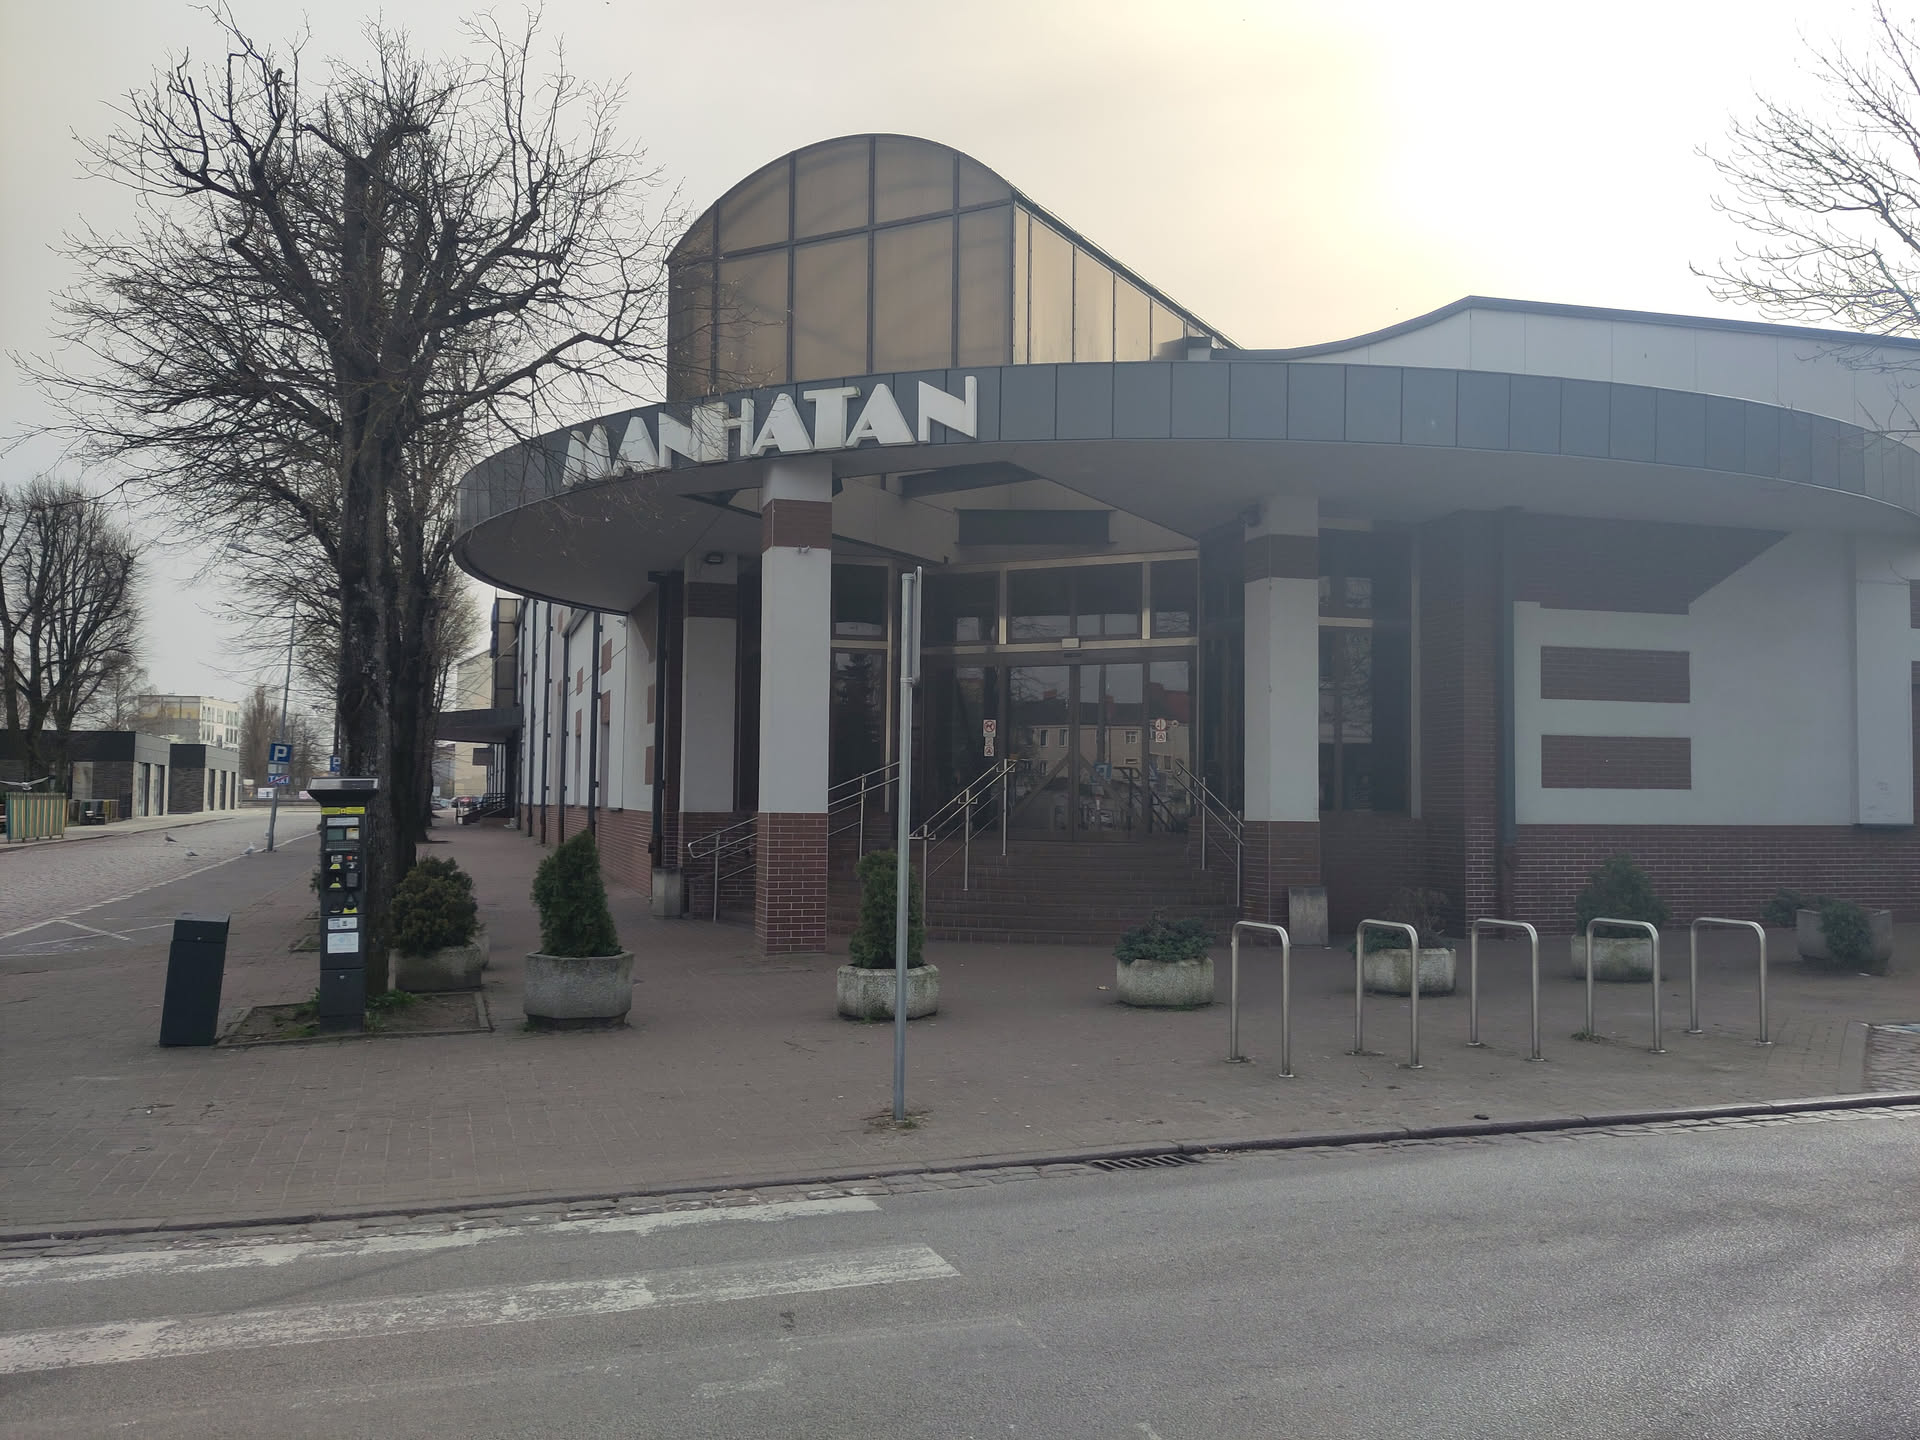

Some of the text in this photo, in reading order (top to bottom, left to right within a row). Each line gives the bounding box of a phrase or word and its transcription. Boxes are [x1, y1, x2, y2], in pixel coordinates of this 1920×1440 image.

[562, 375, 978, 488] MANHATAN
[274, 745, 288, 761] P
[268, 775, 289, 785] TAXI
